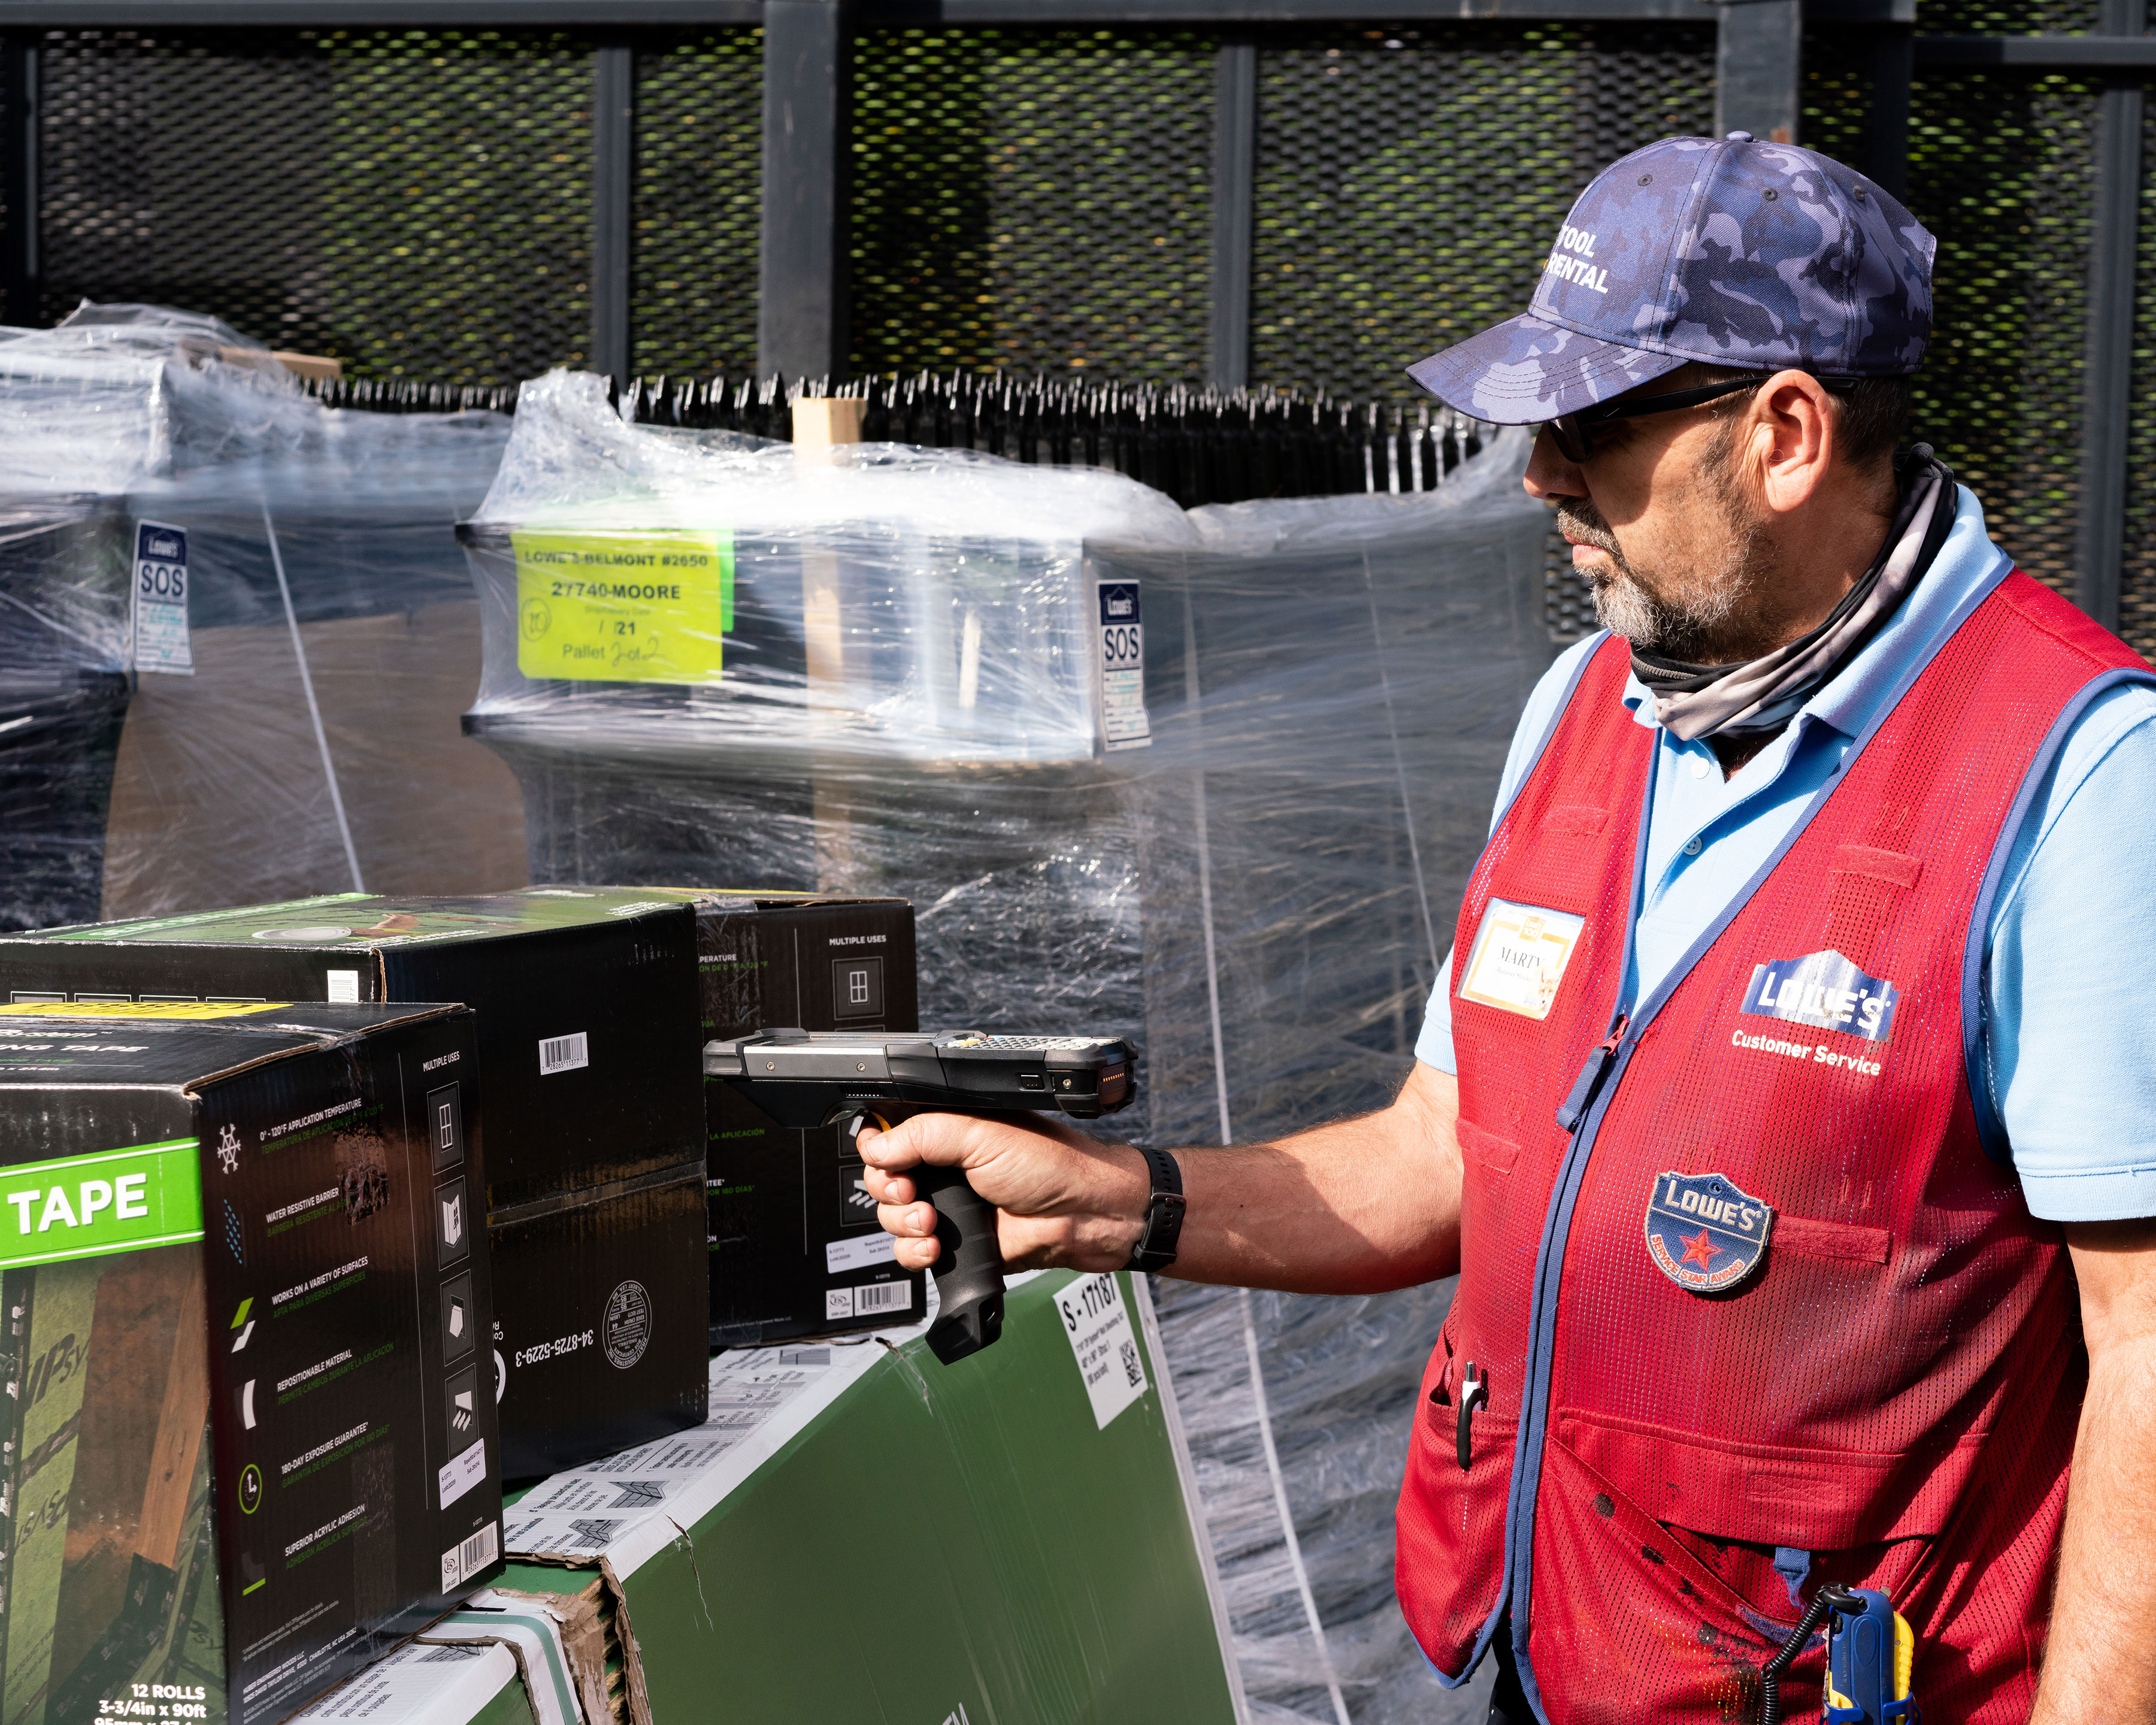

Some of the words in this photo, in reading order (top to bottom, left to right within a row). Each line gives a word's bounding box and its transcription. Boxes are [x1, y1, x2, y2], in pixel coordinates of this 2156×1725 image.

[1557, 225, 1597, 258] TOOL
[1545, 252, 1609, 295] RENTAL
[661, 555, 708, 567] #2650
[141, 565, 183, 597] SOS
[562, 643, 605, 659] Pallet
[628, 646, 641, 662] of
[1105, 628, 1138, 659] SOS
[829, 936, 866, 946] MULTIPLE
[867, 934, 887, 943] USES
[1523, 928, 1539, 937] 100
[700, 954, 737, 963] PERATURE
[1497, 946, 1547, 969] MARTY
[1758, 972, 1884, 1031] LOWE'S
[423, 1055, 447, 1072] MULTIPLE
[447, 1051, 460, 1063] USES
[549, 1061, 564, 1070] 28265
[565, 1058, 579, 1067] 11377
[1732, 1030, 1812, 1059] Customer
[1813, 1045, 1881, 1076] Service
[288, 1110, 324, 1132] APPLICATION
[324, 1097, 362, 1119] TEMPERATURE
[261, 1134, 301, 1155] TEMPERATURA
[302, 1131, 311, 1141] DE
[311, 1118, 344, 1137] APLICACIÓN
[344, 1115, 352, 1125] DE
[720, 1128, 765, 1139] APLICACIÓN
[7, 1172, 148, 1234] TAPE
[266, 1208, 287, 1223] WATER
[287, 1197, 315, 1215] RESISTIVE
[315, 1187, 339, 1204] BARRIER
[1665, 1179, 1755, 1231] LOWE'S
[267, 1219, 294, 1237] BARRERA
[295, 1206, 328, 1226] RESISTENTE
[329, 1203, 336, 1213] AL
[1652, 1235, 1681, 1274] SERVICE
[1679, 1270, 1707, 1284] STAR
[1709, 1260, 1745, 1284] AWARD
[272, 1288, 293, 1305] WORKS
[294, 1284, 303, 1296] ON
[304, 1282, 309, 1292] A
[309, 1271, 332, 1288] VARIETY
[333, 1267, 341, 1278] OF
[341, 1256, 368, 1275] SURFACES
[273, 1305, 288, 1319] APTA
[289, 1298, 304, 1312] PARA
[305, 1285, 332, 1305] DIVERSAS
[333, 1270, 366, 1293] SUPERFICIES
[611, 1291, 619, 1301] MN
[628, 1283, 643, 1293] ALBERT
[516, 1329, 594, 1368] 34-8725-5229-3
[613, 1346, 635, 1358] CERTIFICATE
[617, 1337, 638, 1348] SINGLEWALL
[636, 1337, 647, 1357] PRATT
[277, 1361, 325, 1392] REPOSITIONABLE
[326, 1349, 352, 1369] MATERIAL
[278, 1386, 302, 1406] PERMITE
[303, 1374, 328, 1393] CAMBIOS
[329, 1361, 355, 1381] DURANTE
[355, 1357, 362, 1369] LA
[363, 1342, 393, 1364] APLICACIÓN
[281, 1454, 305, 1474] 180-DAY
[305, 1439, 334, 1463] EXPOSURE
[282, 1467, 311, 1488] GARANTÍA
[312, 1462, 320, 1472] DE
[355, 1439, 365, 1449] POR
[367, 1432, 375, 1443] 180
[285, 1533, 313, 1556] SUPERIOR
[314, 1520, 337, 1541] ACRYLIC
[338, 1503, 365, 1527] ADHESION
[341, 1515, 368, 1538] SUPERIOR
[446, 1561, 453, 1570] ES
[468, 1560, 479, 1574] 28265
[480, 1552, 491, 1566] 11377
[267, 1674, 283, 1688] TAYLOR
[332, 1639, 338, 1648] NC
[281, 1656, 297, 1669] WOODS
[296, 1651, 305, 1660] LLC
[131, 1684, 149, 1697] 12
[153, 1684, 206, 1700] ROLLS
[99, 1700, 156, 1716] 3-3/4in
[158, 1705, 169, 1716] x
[172, 1703, 207, 1718] 90ft
